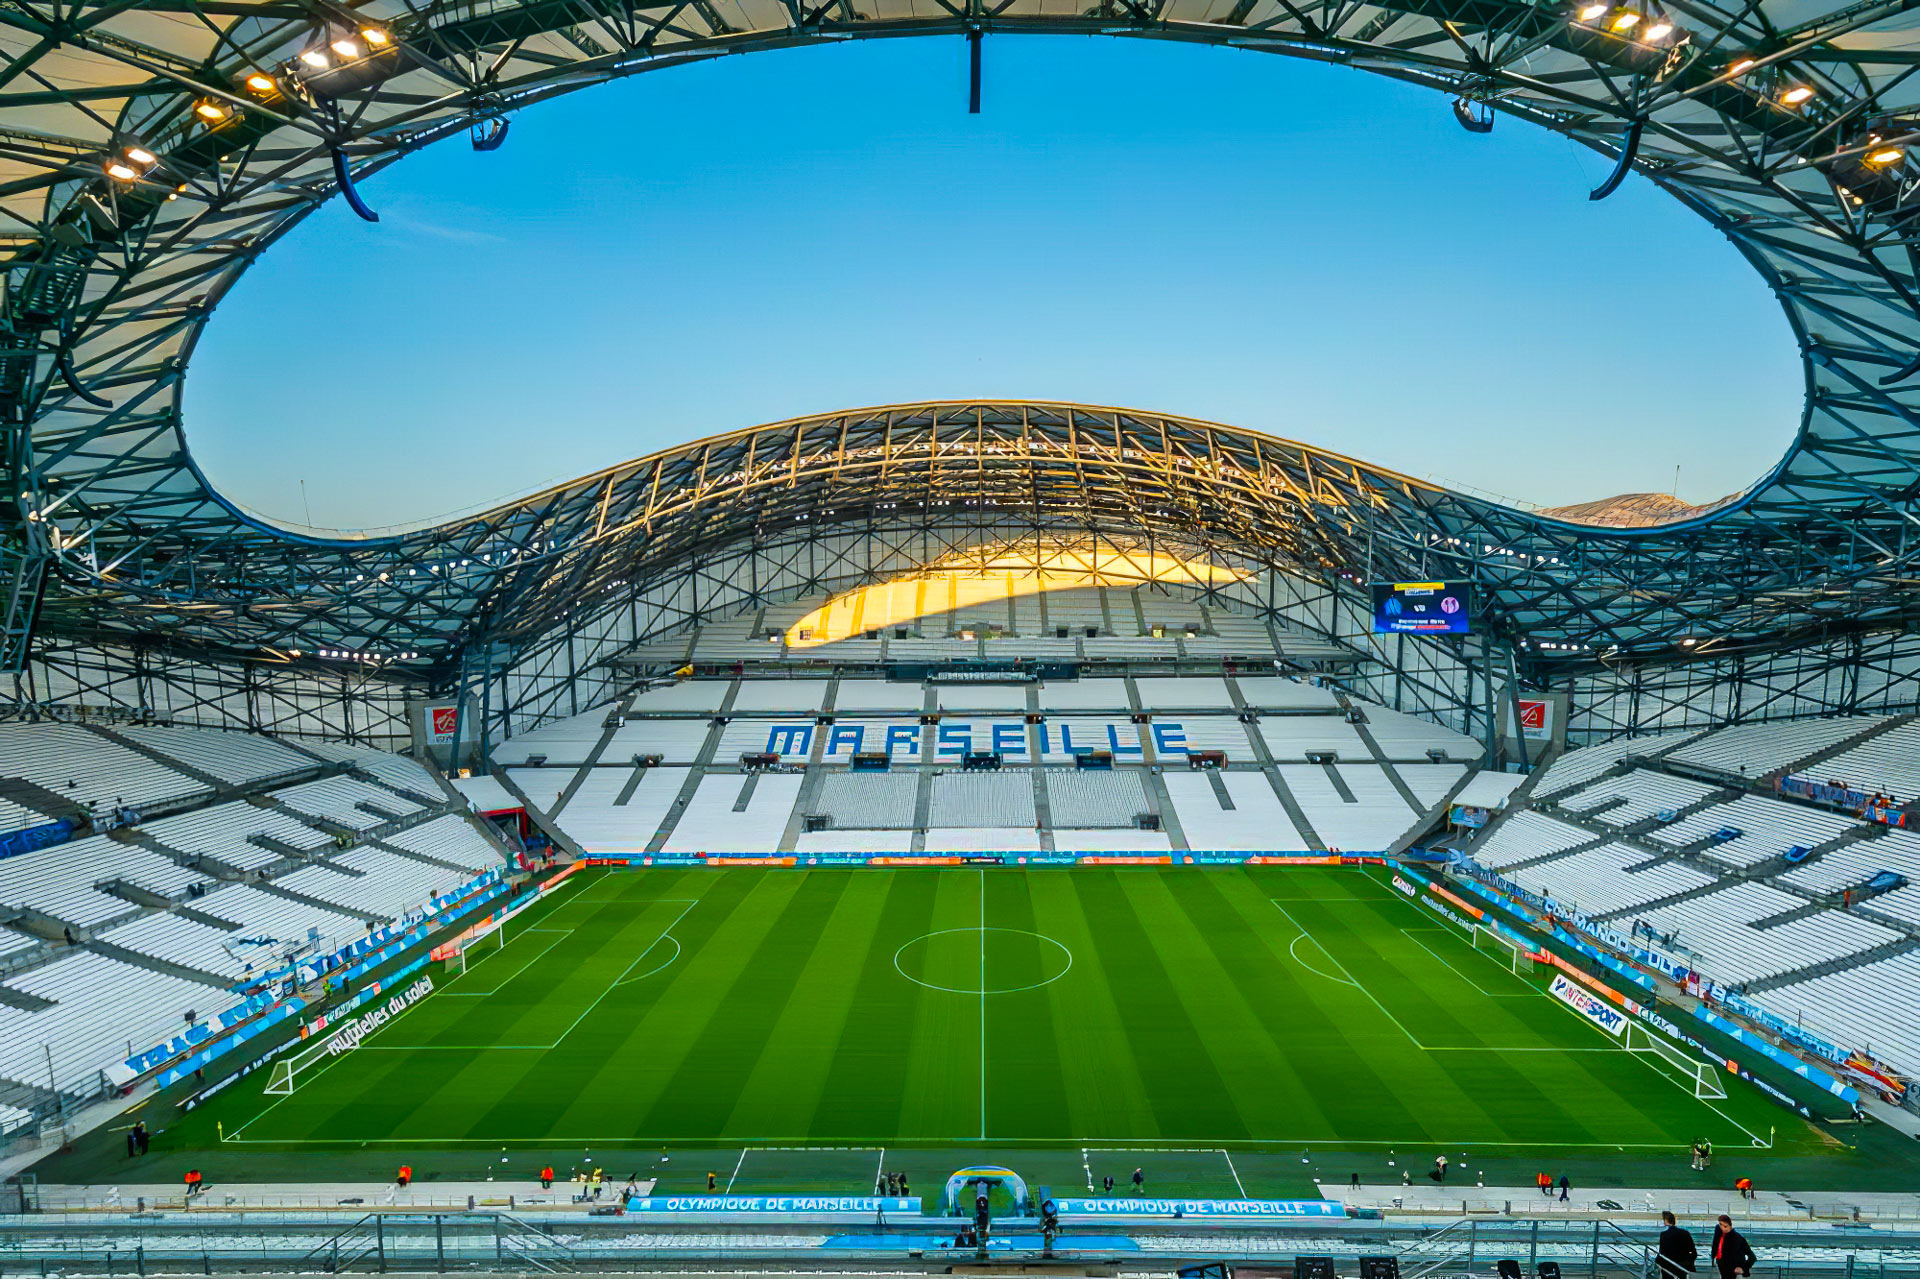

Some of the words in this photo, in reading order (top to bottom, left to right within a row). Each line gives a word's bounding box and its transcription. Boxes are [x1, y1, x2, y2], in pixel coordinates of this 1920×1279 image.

[765, 723, 1189, 755] MARSEILLE
[1544, 899, 1630, 952] COMMANDO
[327, 1006, 391, 1056] mutuelles
[388, 993, 408, 1016] du
[404, 974, 435, 1004] soleil
[1564, 983, 1623, 1031] INTERSPORT
[666, 1197, 761, 1210] OLYMPIQUE
[765, 1198, 787, 1210] DE
[792, 1198, 882, 1211] MARSEILLE
[1083, 1200, 1180, 1213] OLYMPIQUE
[1187, 1201, 1208, 1213] DE
[1212, 1200, 1305, 1214] MARSEILLE
